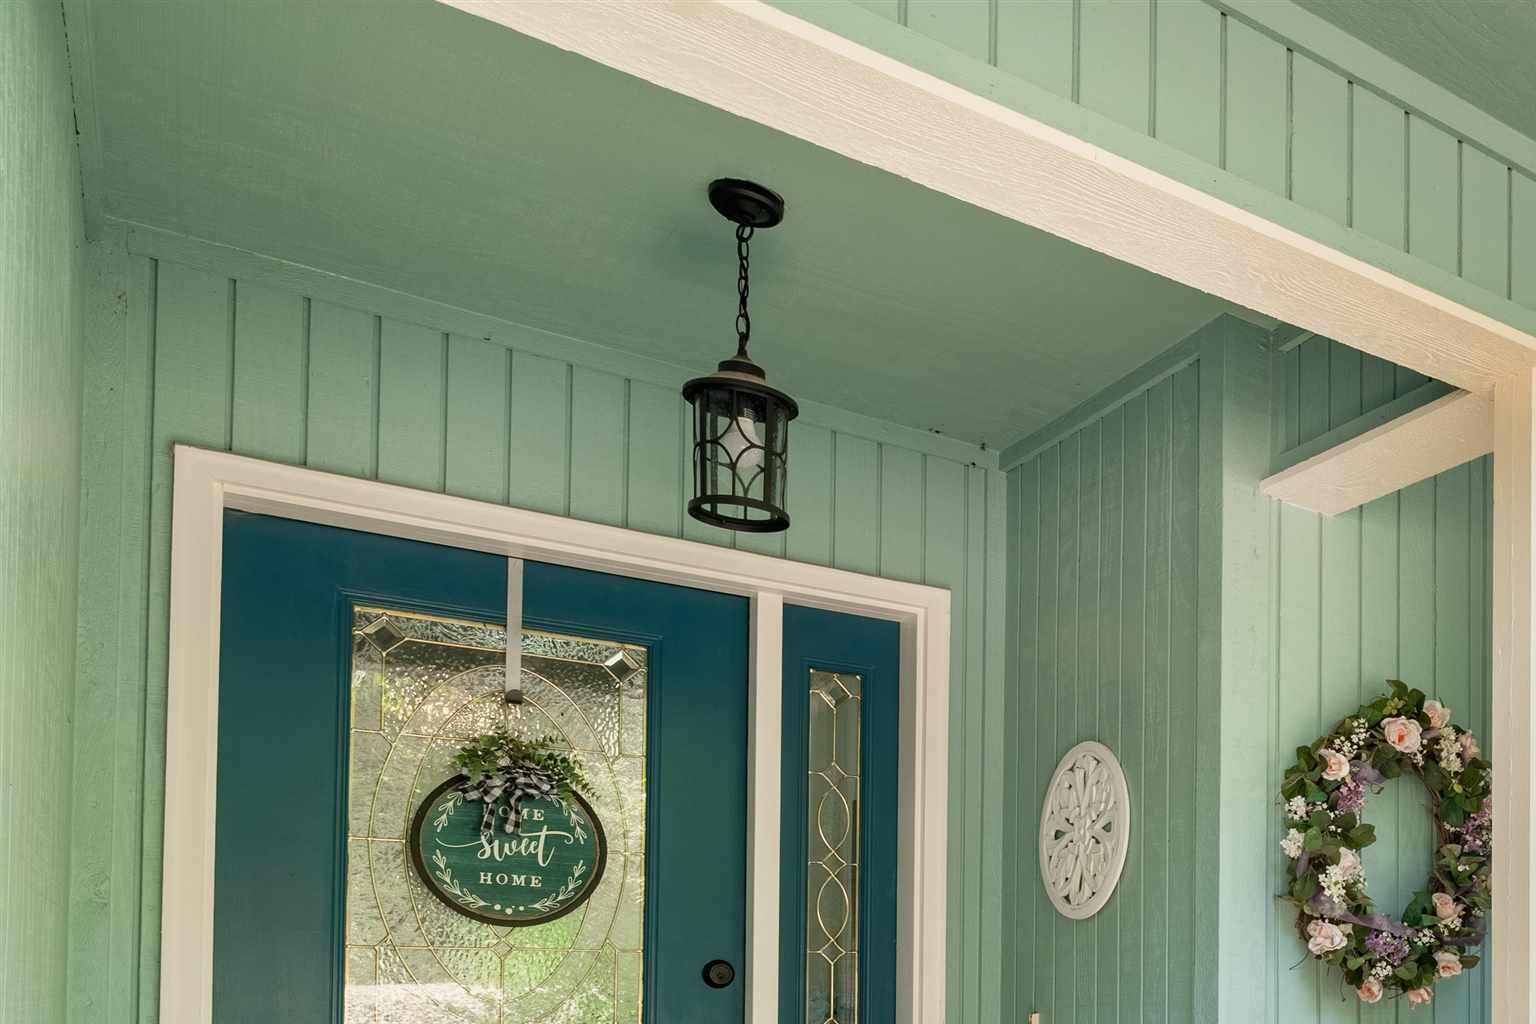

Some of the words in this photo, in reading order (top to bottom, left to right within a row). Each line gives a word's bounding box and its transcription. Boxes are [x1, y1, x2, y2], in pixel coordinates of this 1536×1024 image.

[499, 806, 545, 821] OME
[478, 825, 574, 867] sweet
[480, 872, 543, 887] HOME
